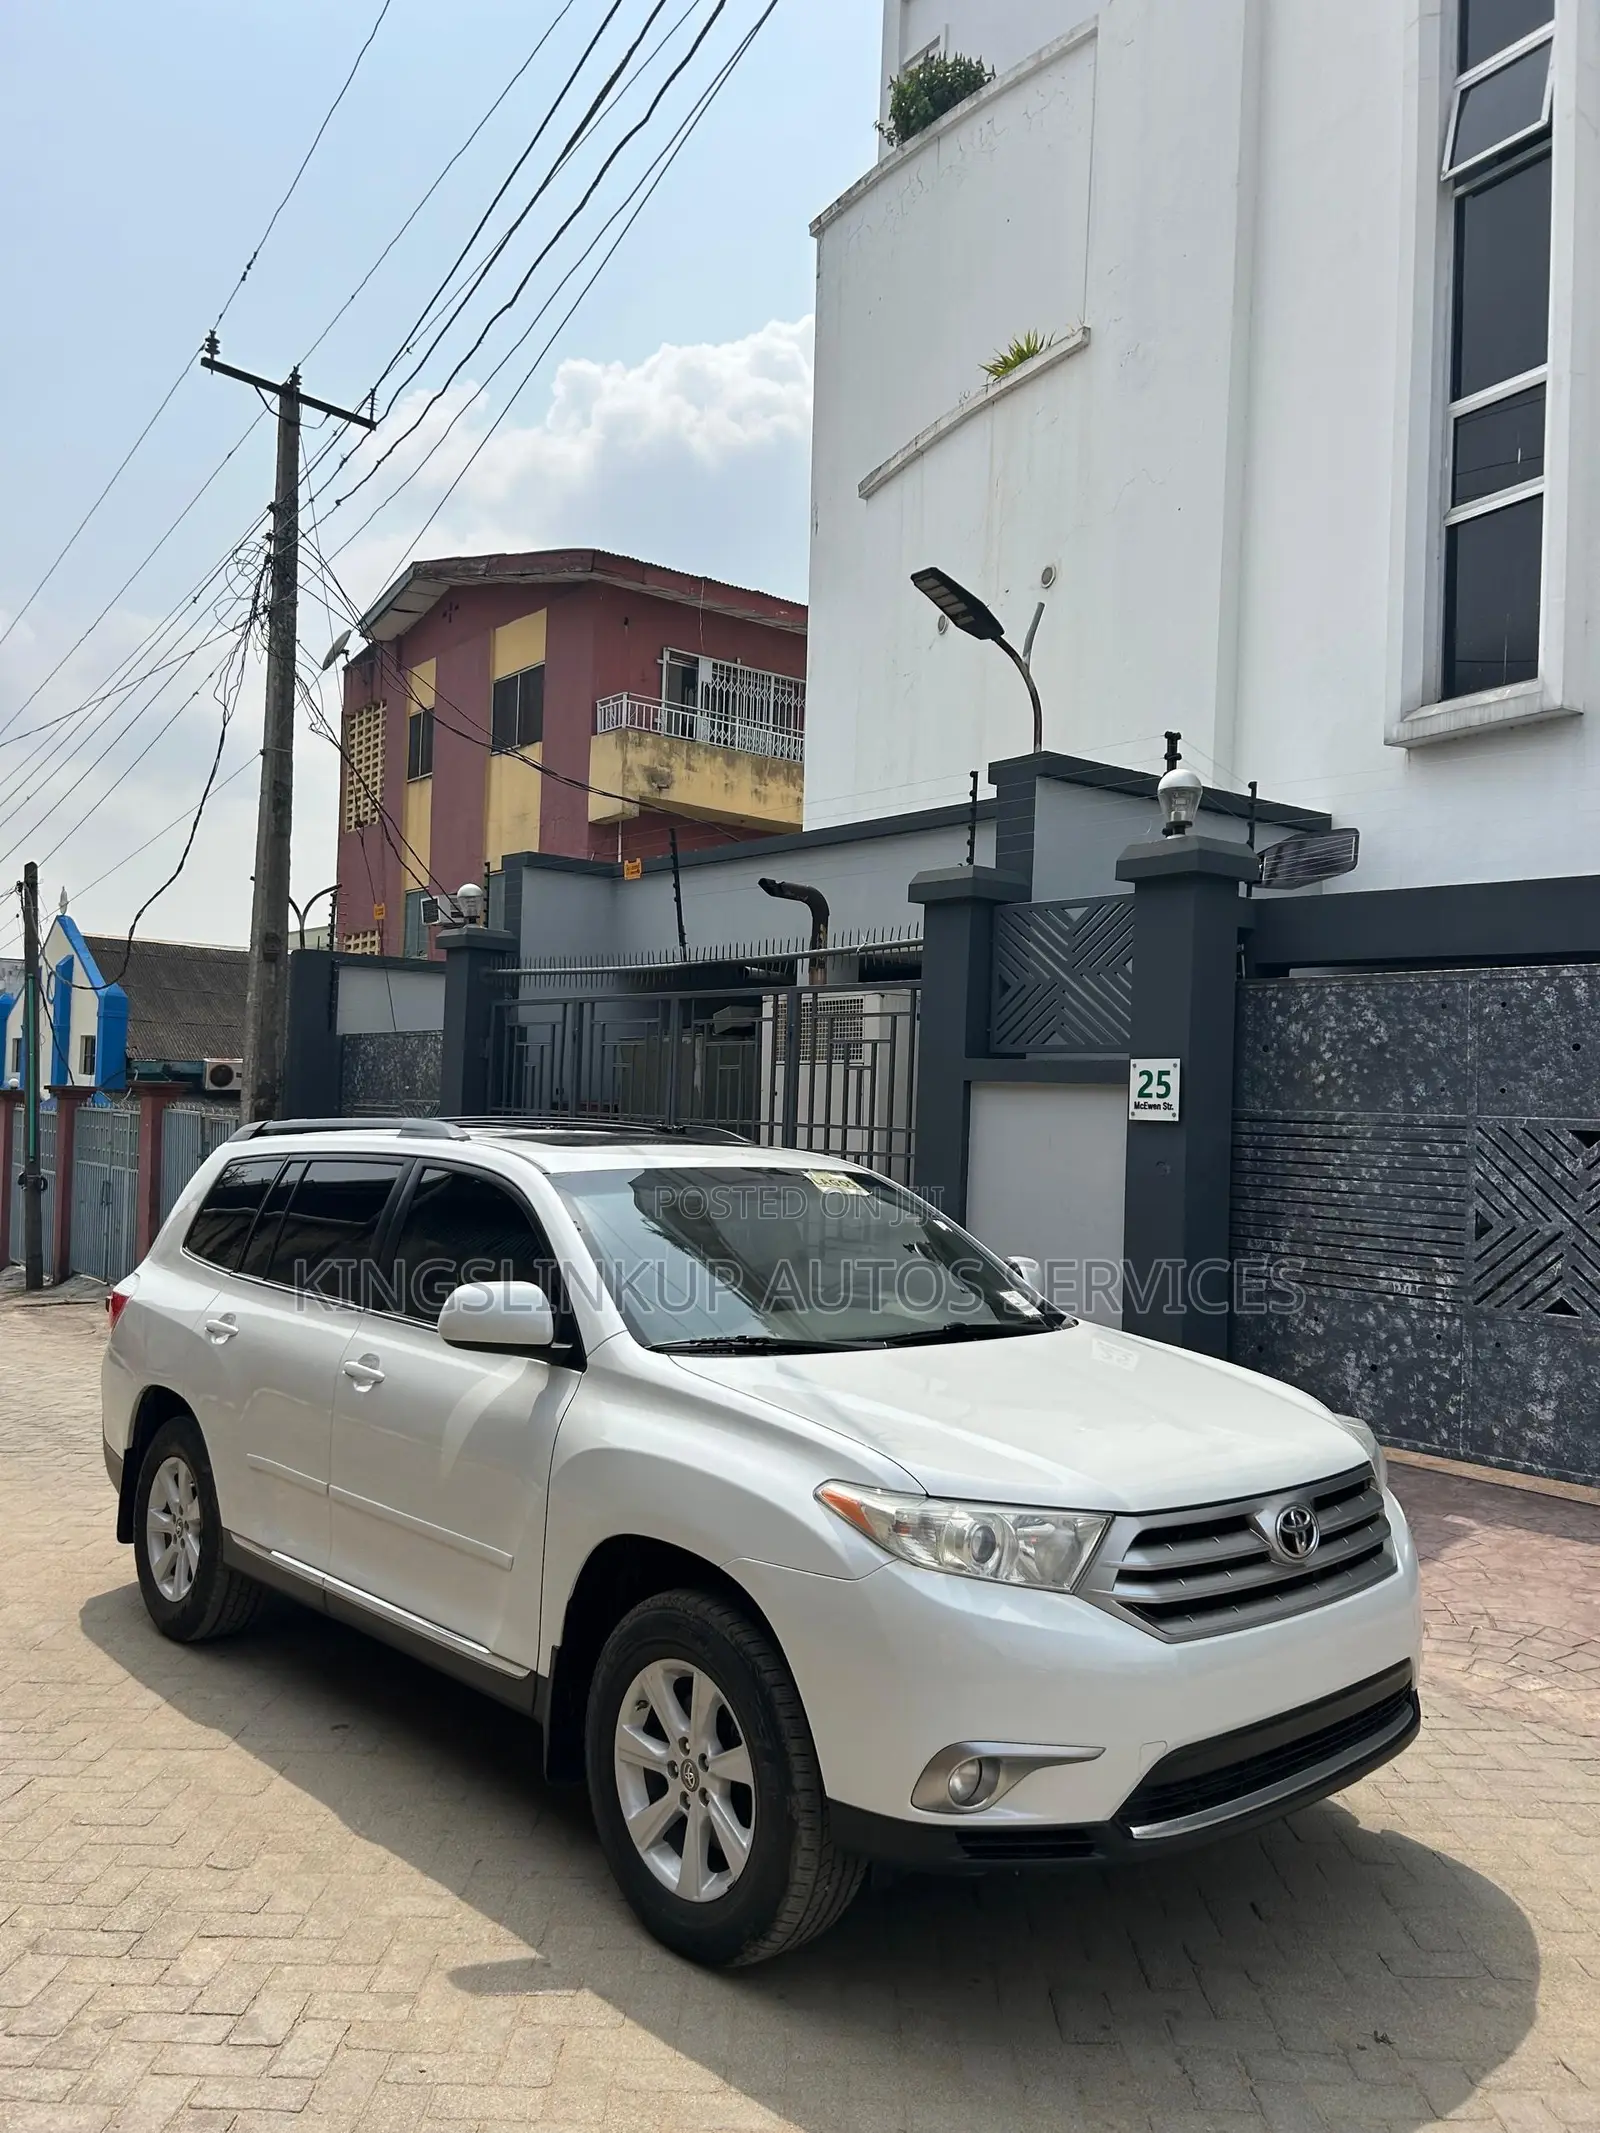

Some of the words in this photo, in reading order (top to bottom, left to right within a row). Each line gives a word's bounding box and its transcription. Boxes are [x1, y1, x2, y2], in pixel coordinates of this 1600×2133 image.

[1137, 1069, 1172, 1099] 25
[1133, 1101, 1162, 1111] McEwen
[1162, 1101, 1174, 1111] Str.
[811, 1178, 858, 1188] LAGOS
